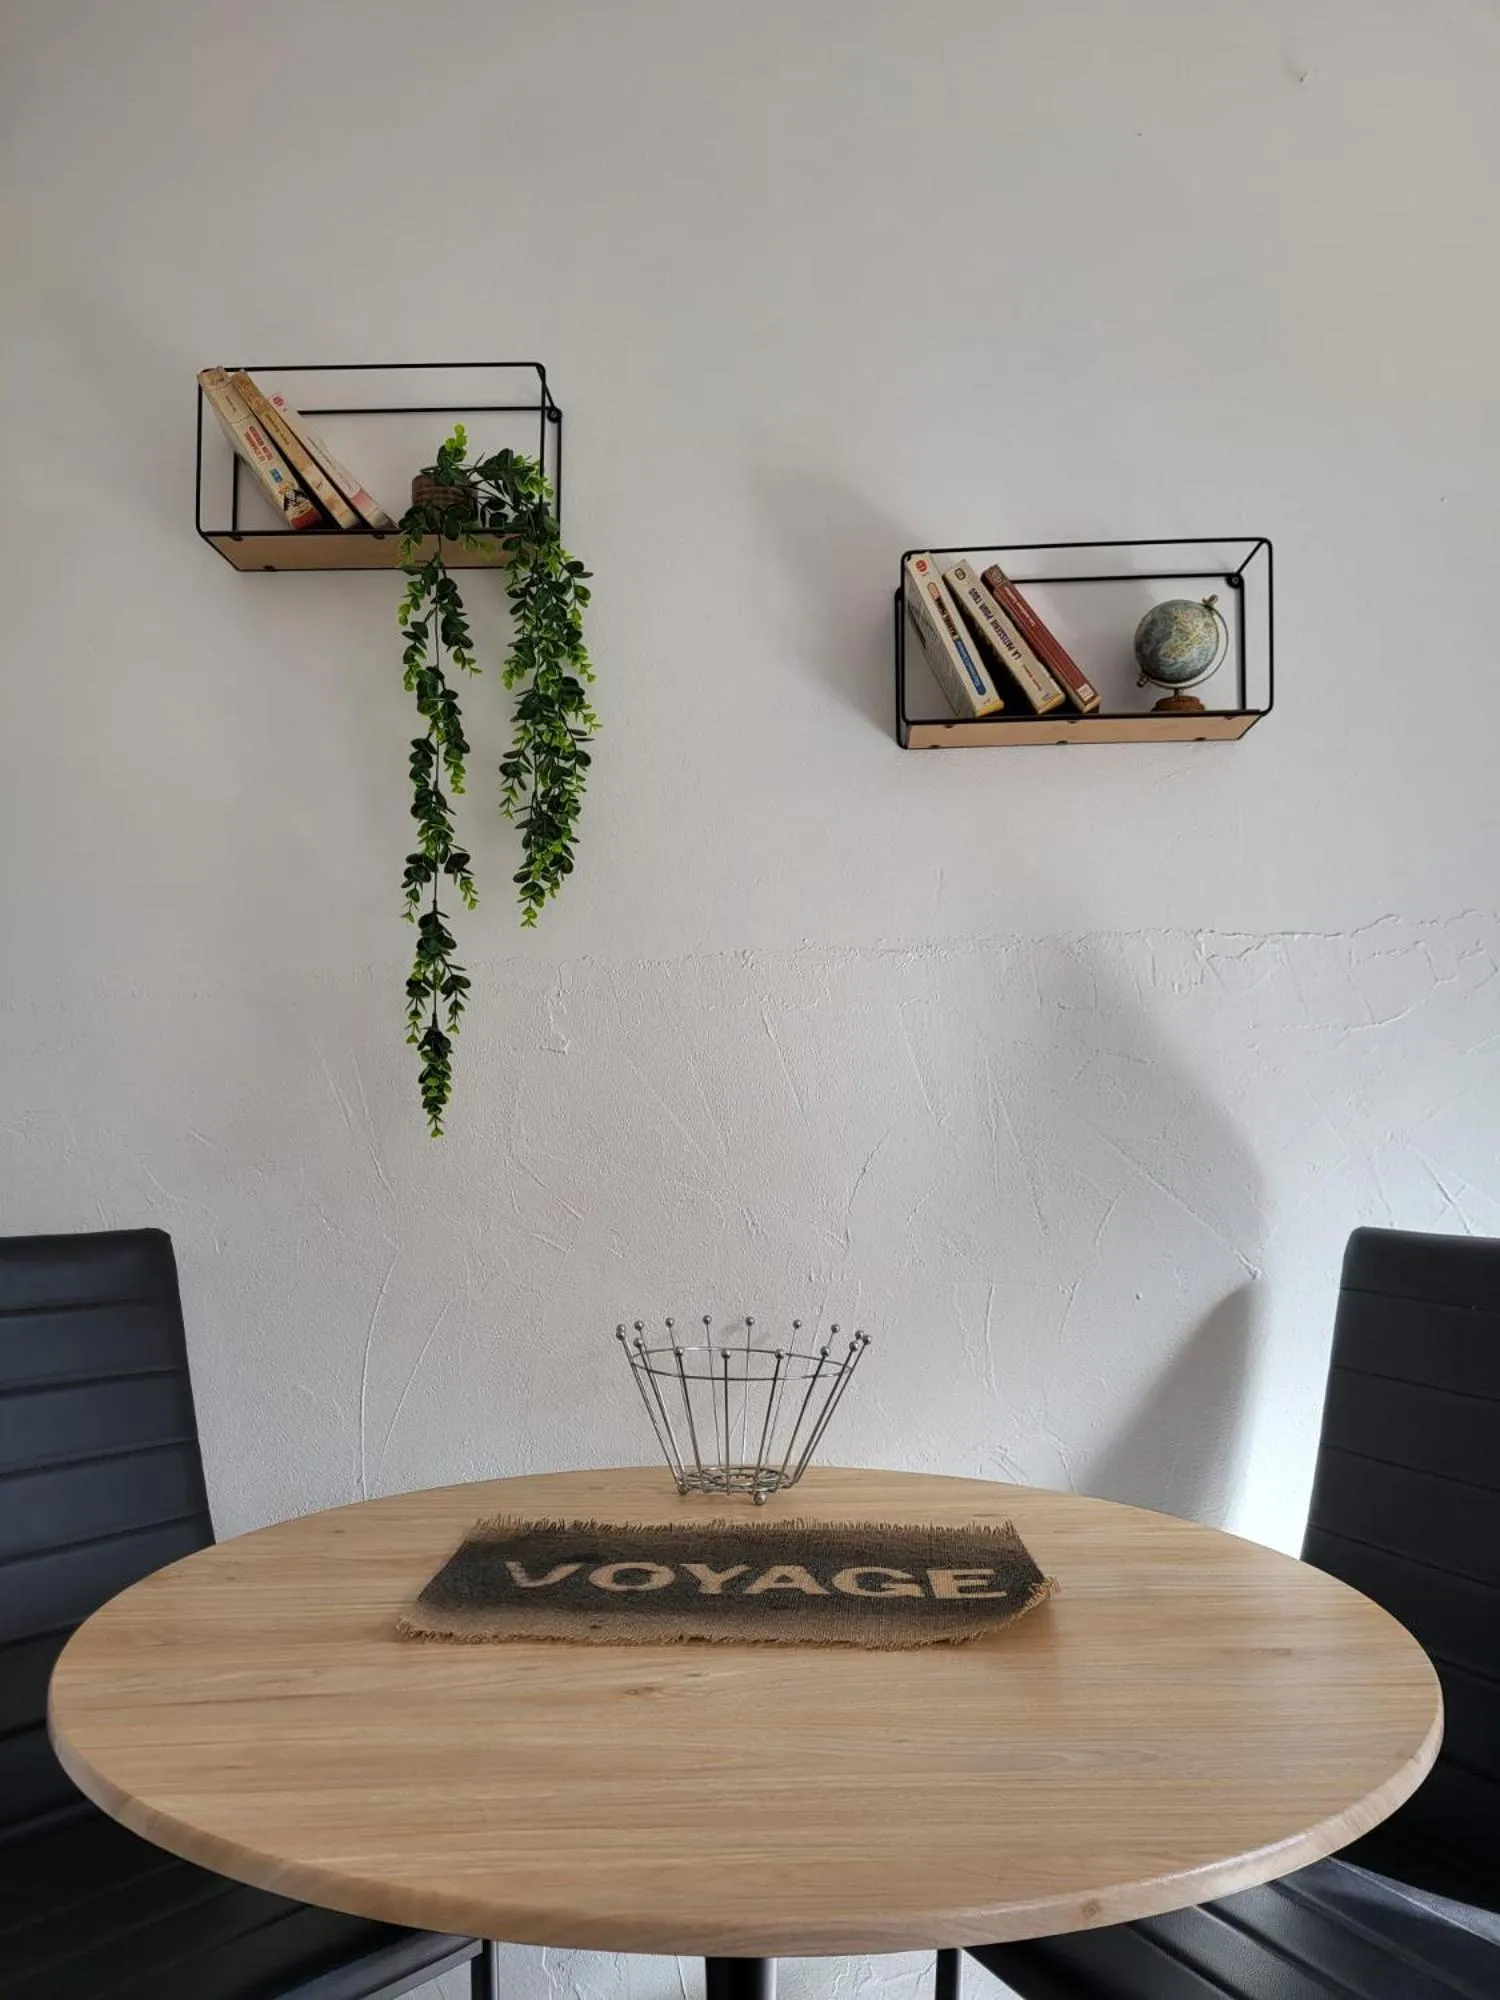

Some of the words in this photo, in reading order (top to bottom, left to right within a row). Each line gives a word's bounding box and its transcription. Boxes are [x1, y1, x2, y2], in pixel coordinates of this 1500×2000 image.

[968, 587, 982, 605] TOUS
[979, 602, 994, 620] POUR
[990, 619, 1016, 652] PATISSERIE
[1012, 648, 1022, 660] LA
[505, 1561, 1007, 1600] VOYAGE
